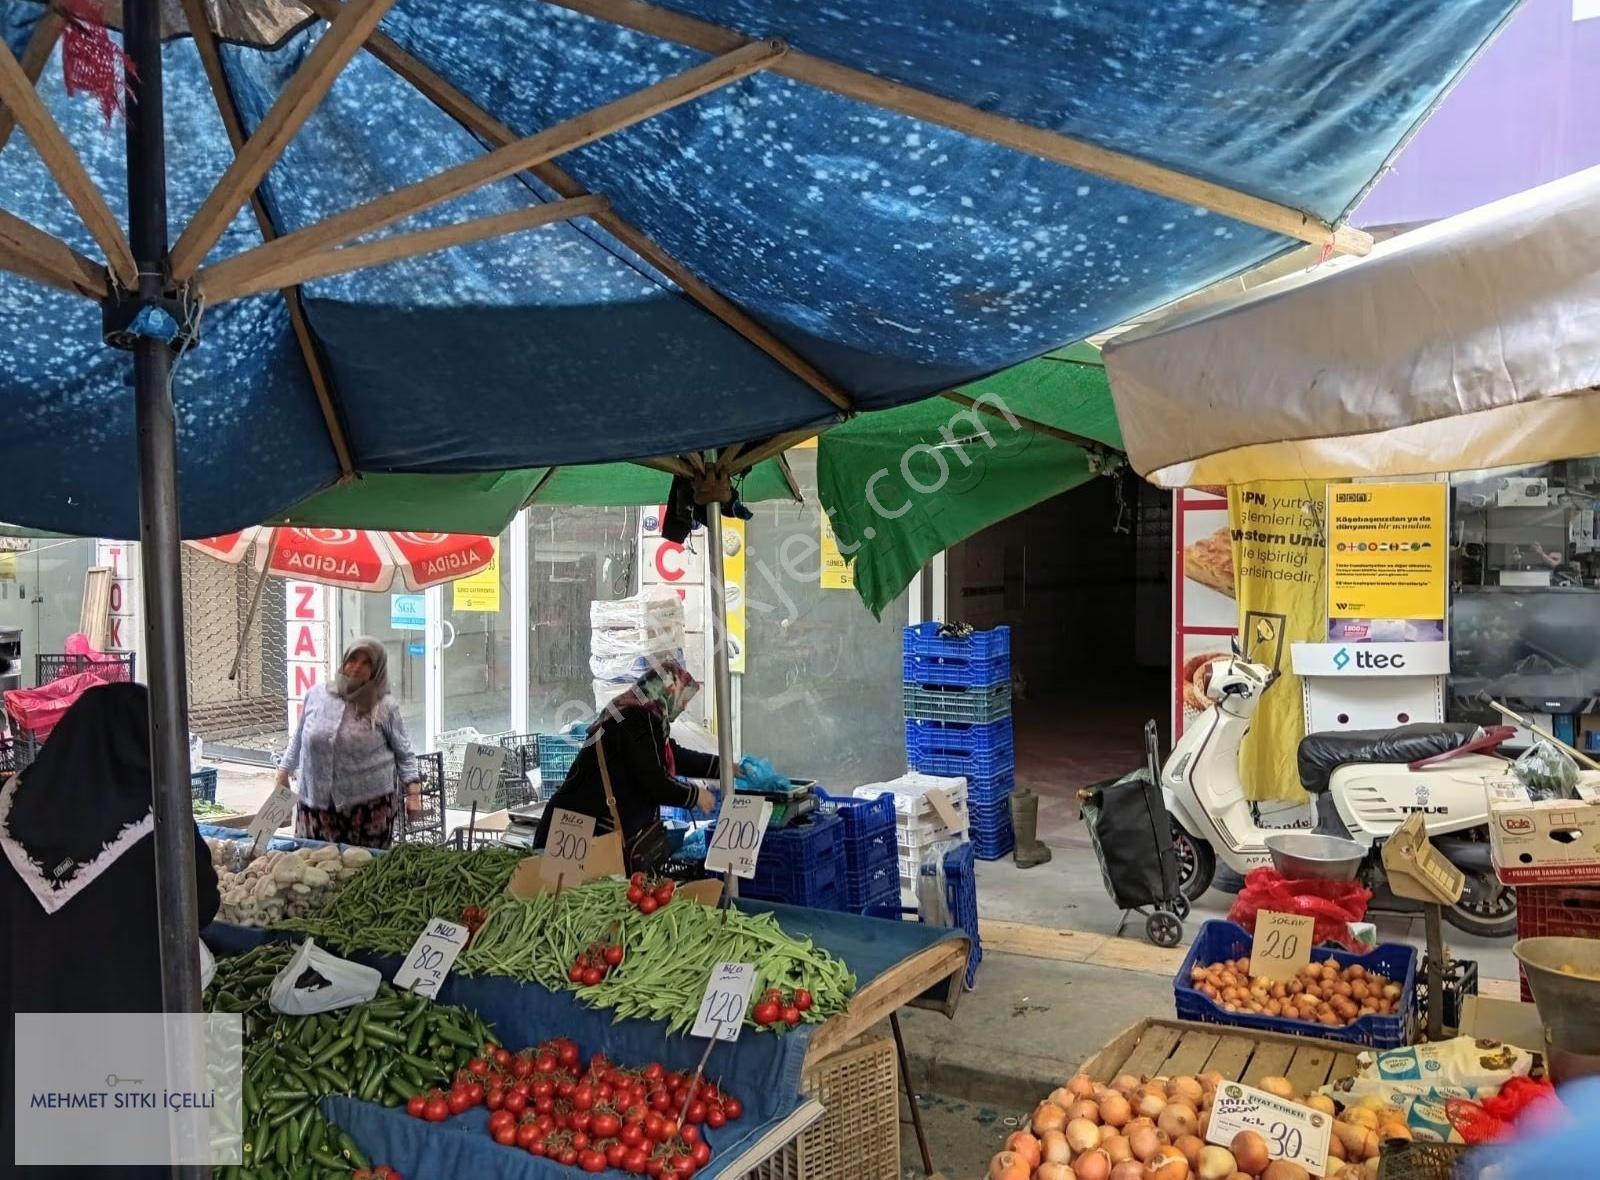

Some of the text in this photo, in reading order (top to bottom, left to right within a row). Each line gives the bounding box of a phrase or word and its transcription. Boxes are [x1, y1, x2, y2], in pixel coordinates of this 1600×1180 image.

[1356, 651, 1405, 669] ttec
[464, 766, 493, 791] 100
[1506, 819, 1531, 829] Dole
[550, 830, 587, 860] 300
[413, 944, 443, 969] 80
[1261, 930, 1298, 960] 20
[705, 990, 742, 1023] 120
[1270, 1121, 1303, 1159] 30
